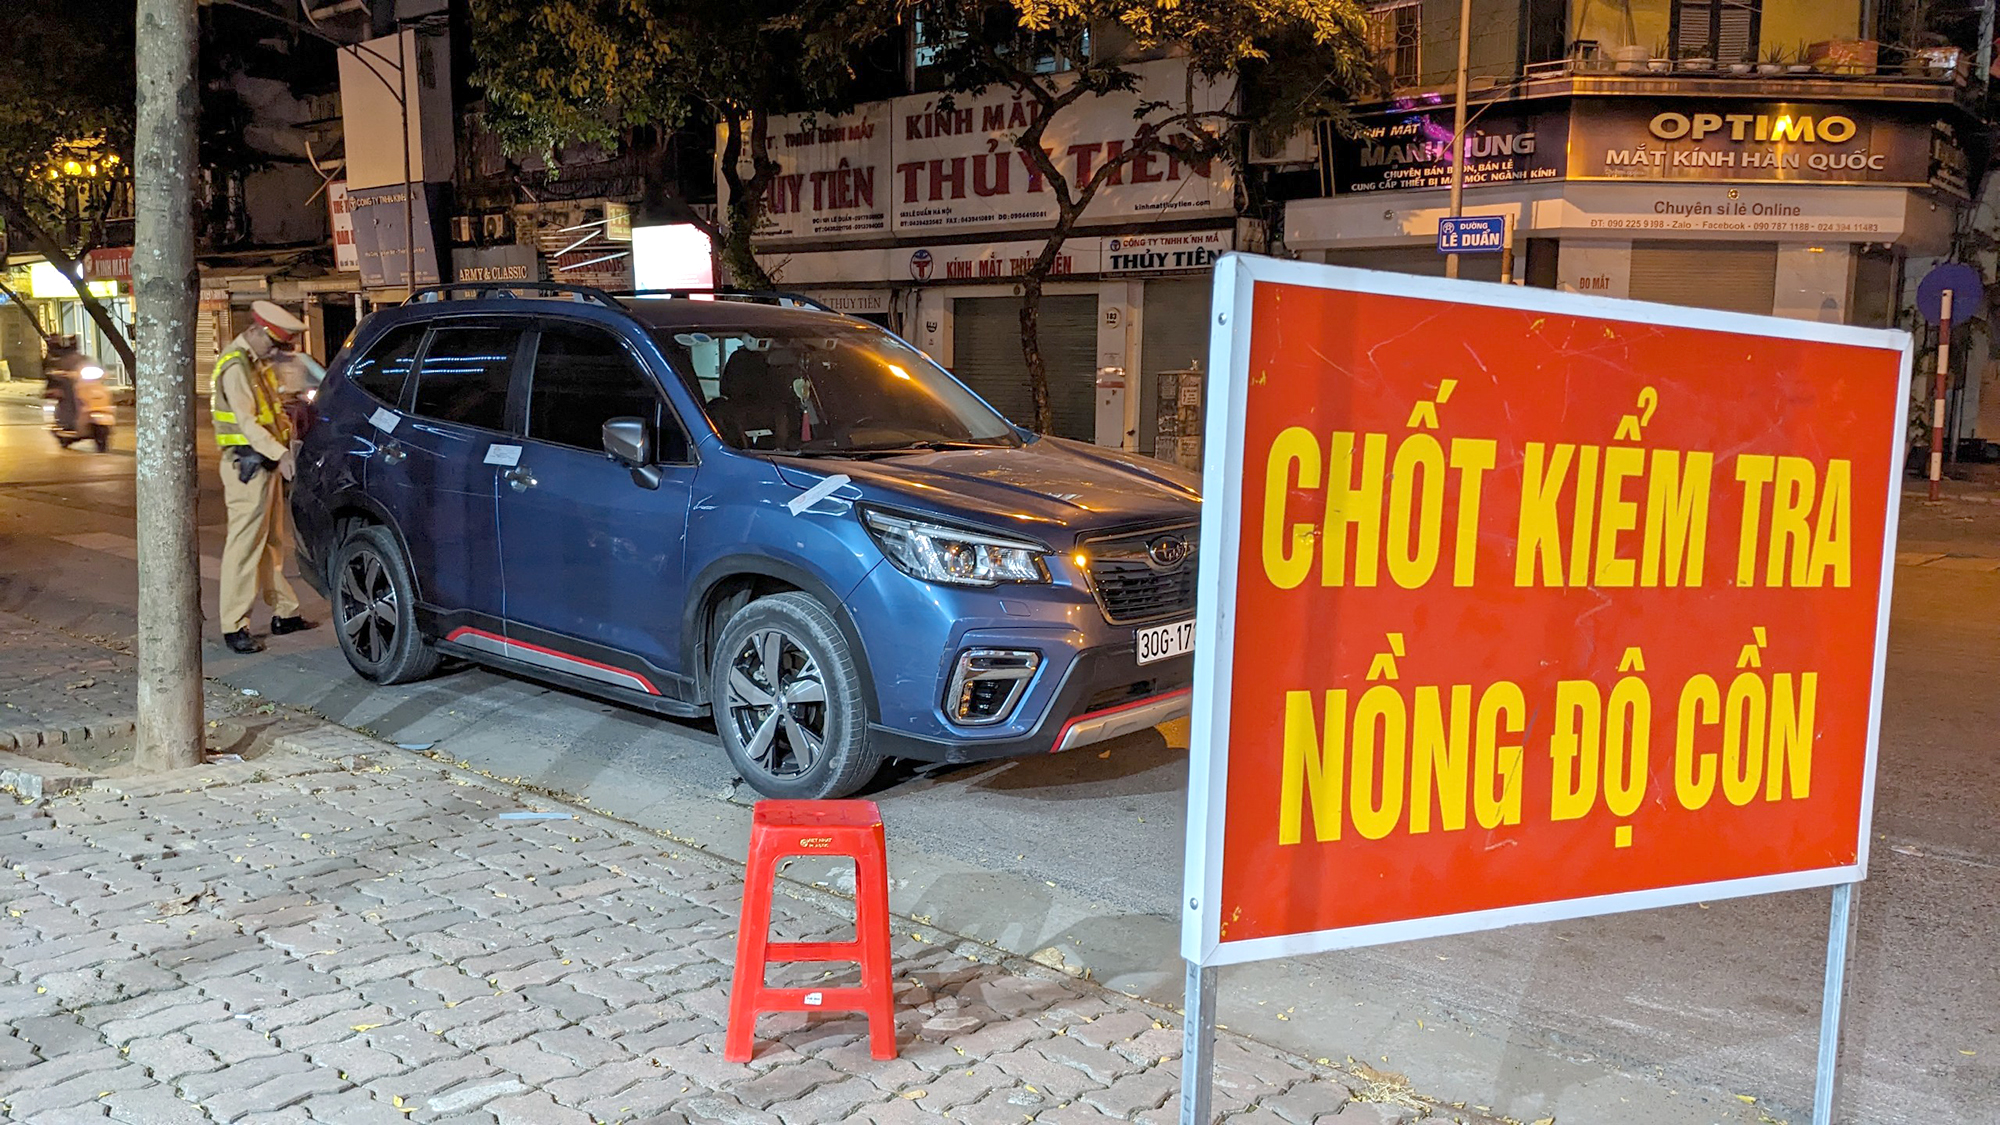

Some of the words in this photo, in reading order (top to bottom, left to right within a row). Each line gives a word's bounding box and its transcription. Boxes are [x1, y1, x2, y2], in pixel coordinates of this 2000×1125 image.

[906, 102, 973, 141] KÍNH
[1649, 112, 1858, 143] OPTIMO
[1605, 143, 1667, 167] MẮT
[1673, 146, 1735, 168] KÍNH
[1741, 147, 1800, 169] HÀN
[1807, 148, 1885, 171] QUỐC
[896, 138, 1055, 204] THỦY
[1351, 182, 1376, 191] CUNG
[1378, 175, 1397, 190] CẤP
[1400, 173, 1425, 188] THIẾT
[1428, 176, 1438, 188] BỊ
[1464, 170, 1488, 184] MÓC
[1491, 169, 1527, 181] NGÀNH
[1530, 167, 1557, 179] KÍNH
[1383, 167, 1421, 180] CHUYÊN
[1424, 164, 1444, 178] BÁN
[1479, 160, 1499, 172] BÁN
[809, 157, 875, 211] TIÊN
[1654, 200, 1712, 218] Chuyên
[1752, 202, 1801, 216] Online
[1459, 221, 1489, 231] ĐƯỜNG
[1607, 219, 1623, 228] 090
[1625, 219, 1641, 228] 225
[1672, 221, 1692, 229] Zalo
[1702, 221, 1745, 230] Facebook
[1753, 222, 1769, 230] 090
[1771, 222, 1786, 230] 787
[1817, 223, 1833, 231] 024
[1123, 237, 1146, 248] CÔNG
[1148, 237, 1158, 247] TY
[1159, 236, 1182, 246] TNHH
[1441, 231, 1457, 247] LÊ
[1461, 229, 1501, 247] DUẨN
[946, 256, 973, 279] KÍNH
[979, 251, 1003, 278] MẮT
[1110, 247, 1169, 270] THỦY
[1172, 246, 1222, 268] TIÊN
[459, 267, 483, 282] ARMY
[491, 265, 527, 281] CLASSIC
[1580, 278, 1590, 289] ĐO
[1592, 273, 1610, 290] MẮT
[858, 295, 881, 310] TIÊN
[1262, 378, 1497, 590] CHỐT
[1514, 385, 1714, 589] KIỂM
[1735, 453, 1853, 589] TRA
[1141, 622, 1196, 659] 30G-17
[1279, 632, 1527, 847] NỒNG
[1549, 646, 1652, 848] ĐỘ
[1675, 626, 1819, 811] CỒN
